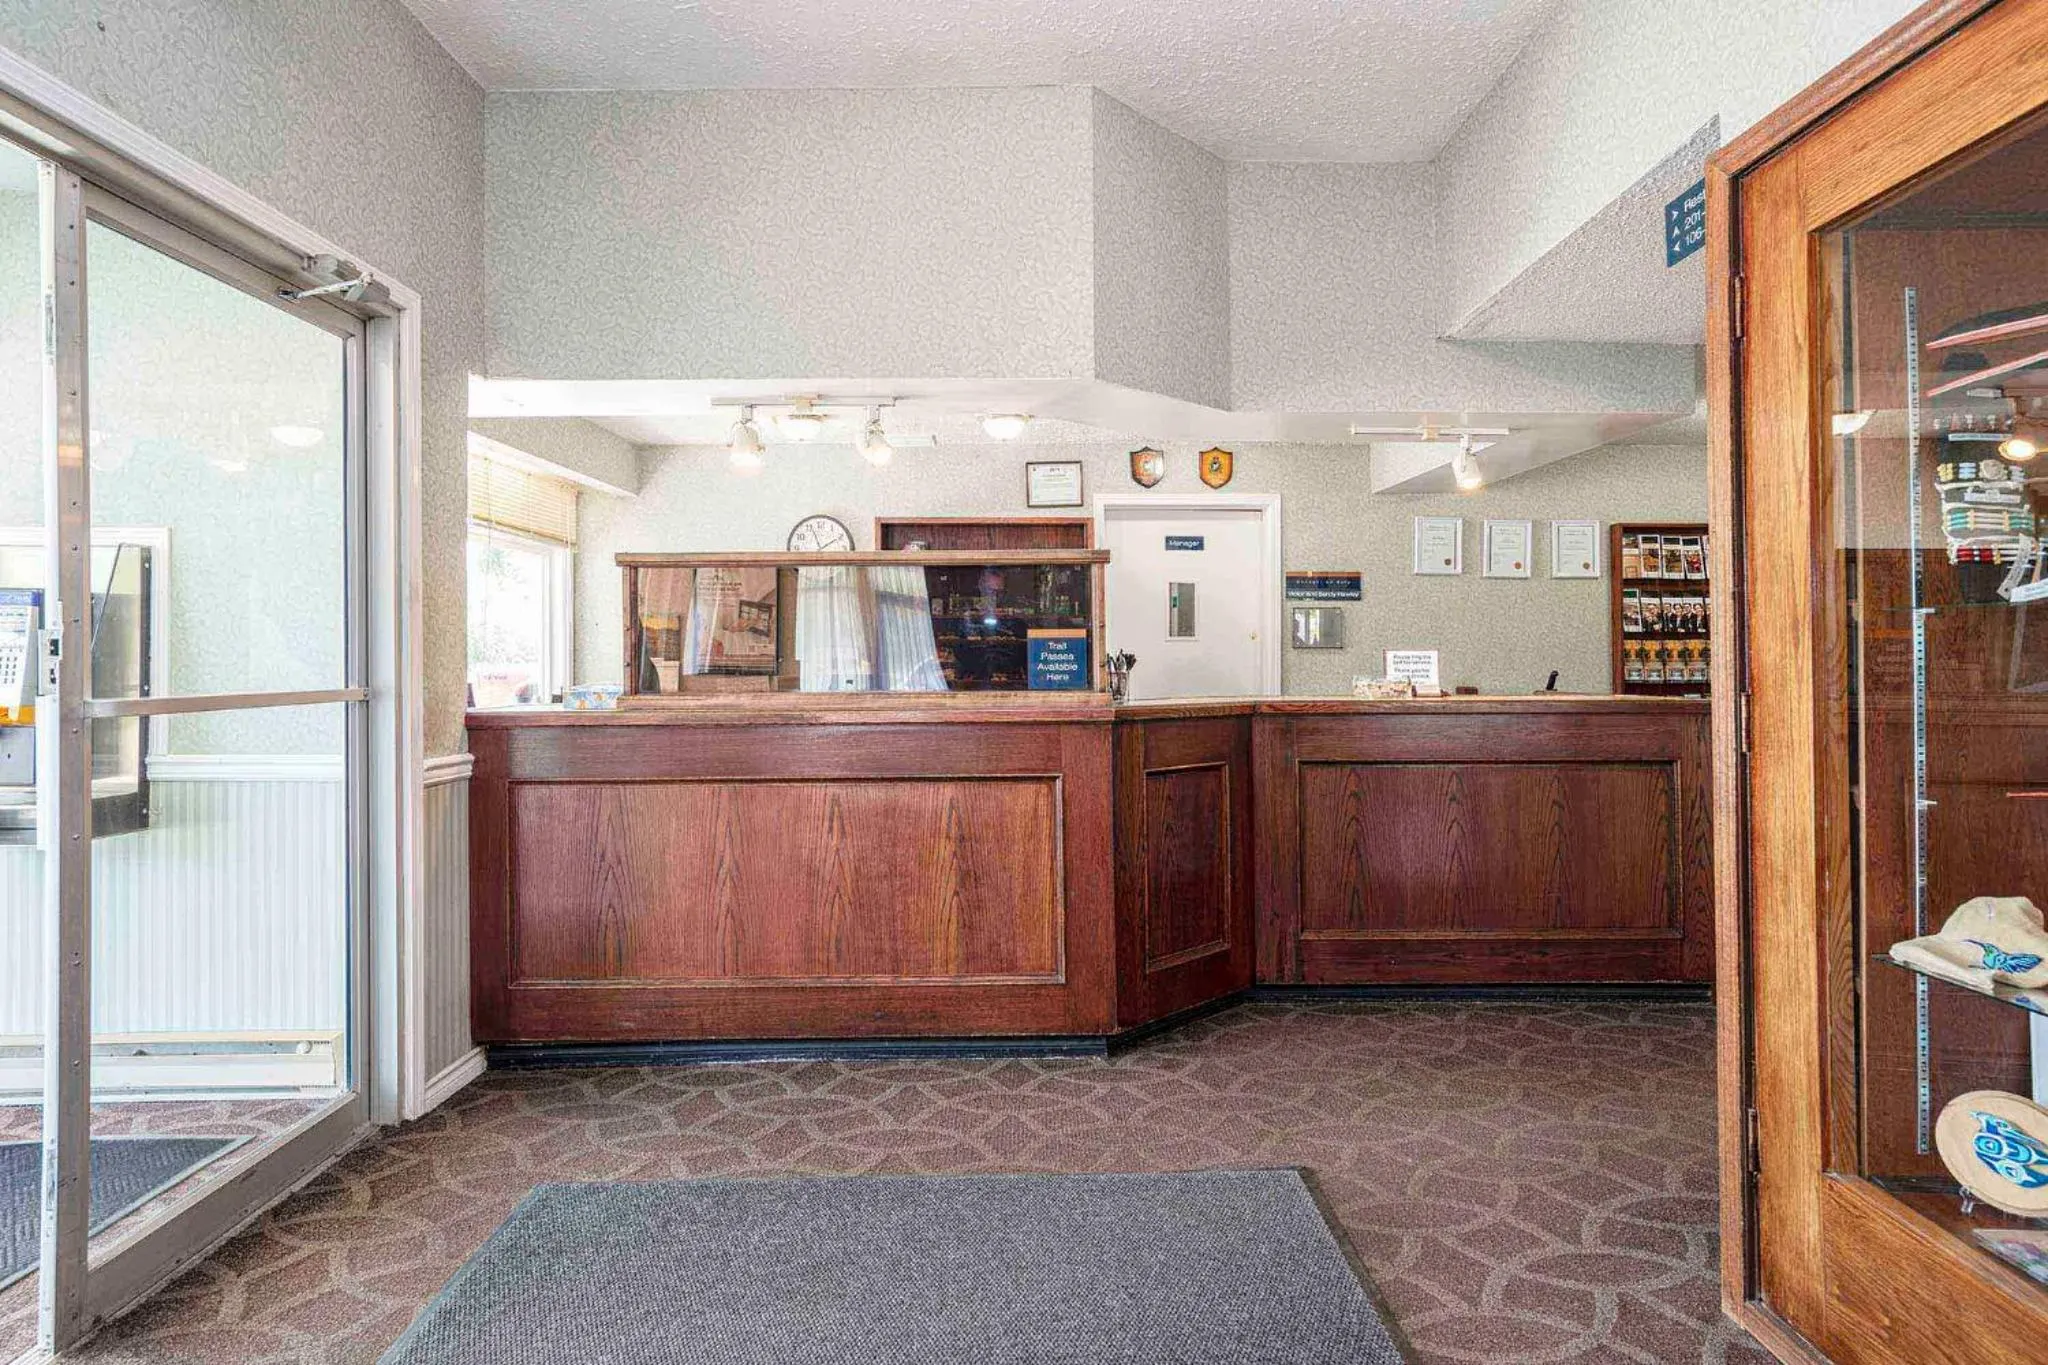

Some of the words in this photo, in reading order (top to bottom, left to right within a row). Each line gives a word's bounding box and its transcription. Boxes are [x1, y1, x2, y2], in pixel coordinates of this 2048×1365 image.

[1169, 540, 1200, 548] Manager
[1048, 642, 1067, 650] Trail
[1040, 652, 1074, 660] Passes
[1037, 662, 1078, 671] Available
[1046, 673, 1069, 681] Here
